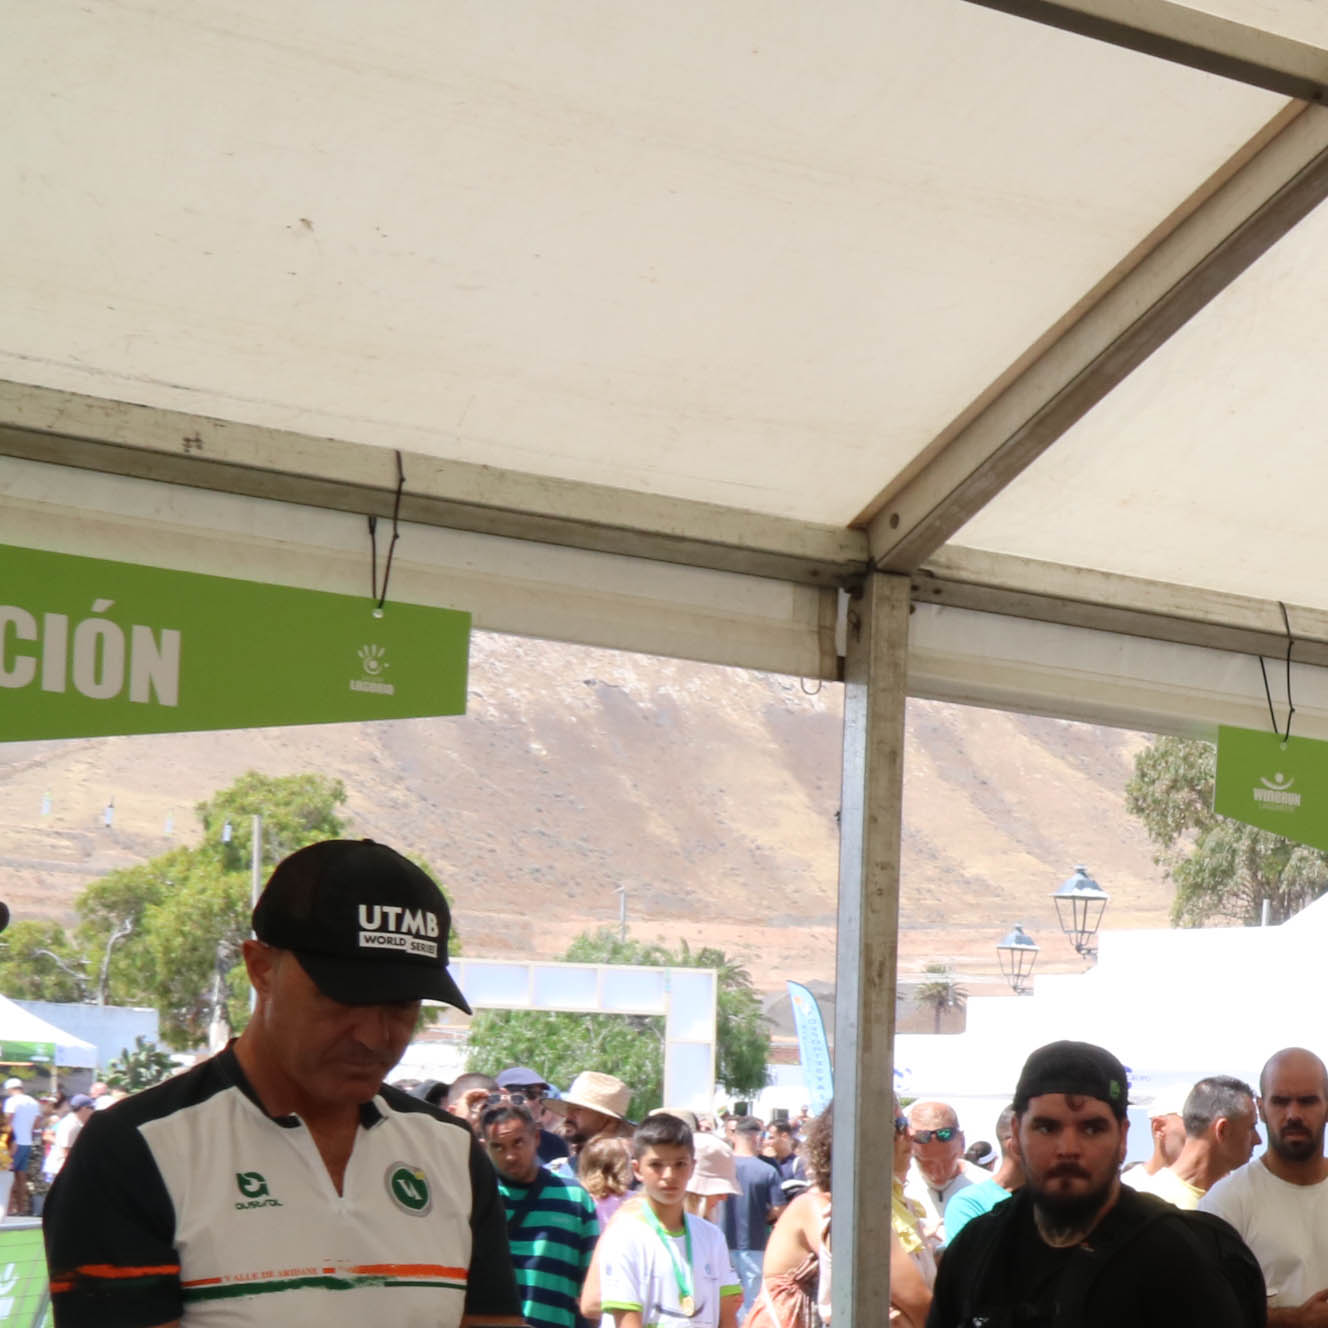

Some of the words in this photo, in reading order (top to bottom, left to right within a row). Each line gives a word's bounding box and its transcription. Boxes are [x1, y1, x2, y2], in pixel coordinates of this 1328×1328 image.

[359, 904, 440, 938] UTMB
[363, 934, 407, 947] WORLD
[410, 941, 435, 954] SERIES
